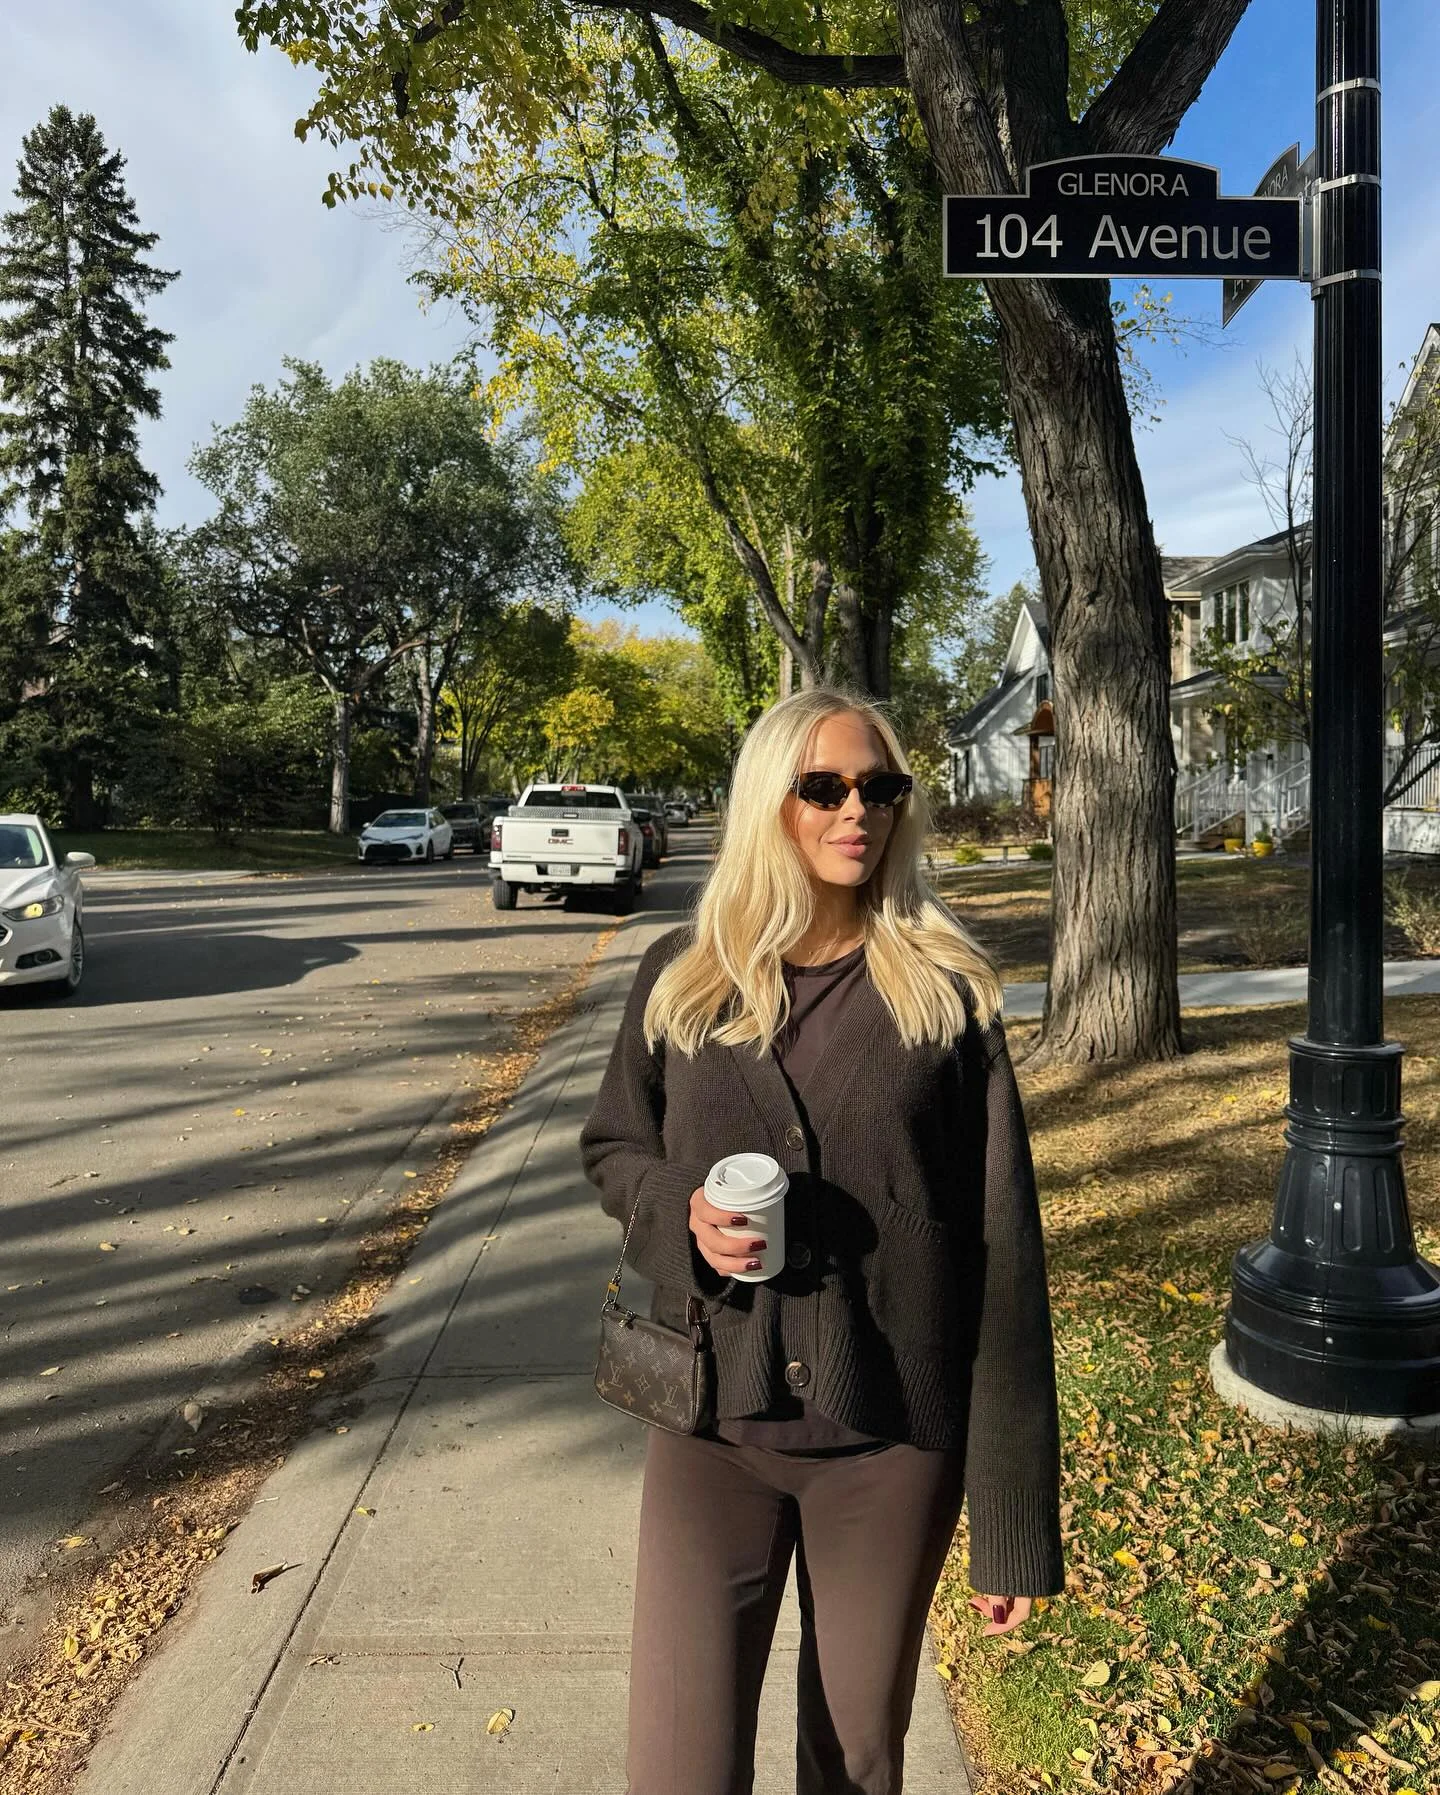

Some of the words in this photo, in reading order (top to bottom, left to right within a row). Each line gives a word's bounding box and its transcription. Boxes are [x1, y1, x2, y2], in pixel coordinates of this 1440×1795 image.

[1057, 173, 1189, 197] GLENORA
[975, 214, 1063, 259] 104
[1088, 214, 1271, 260] Avenue
